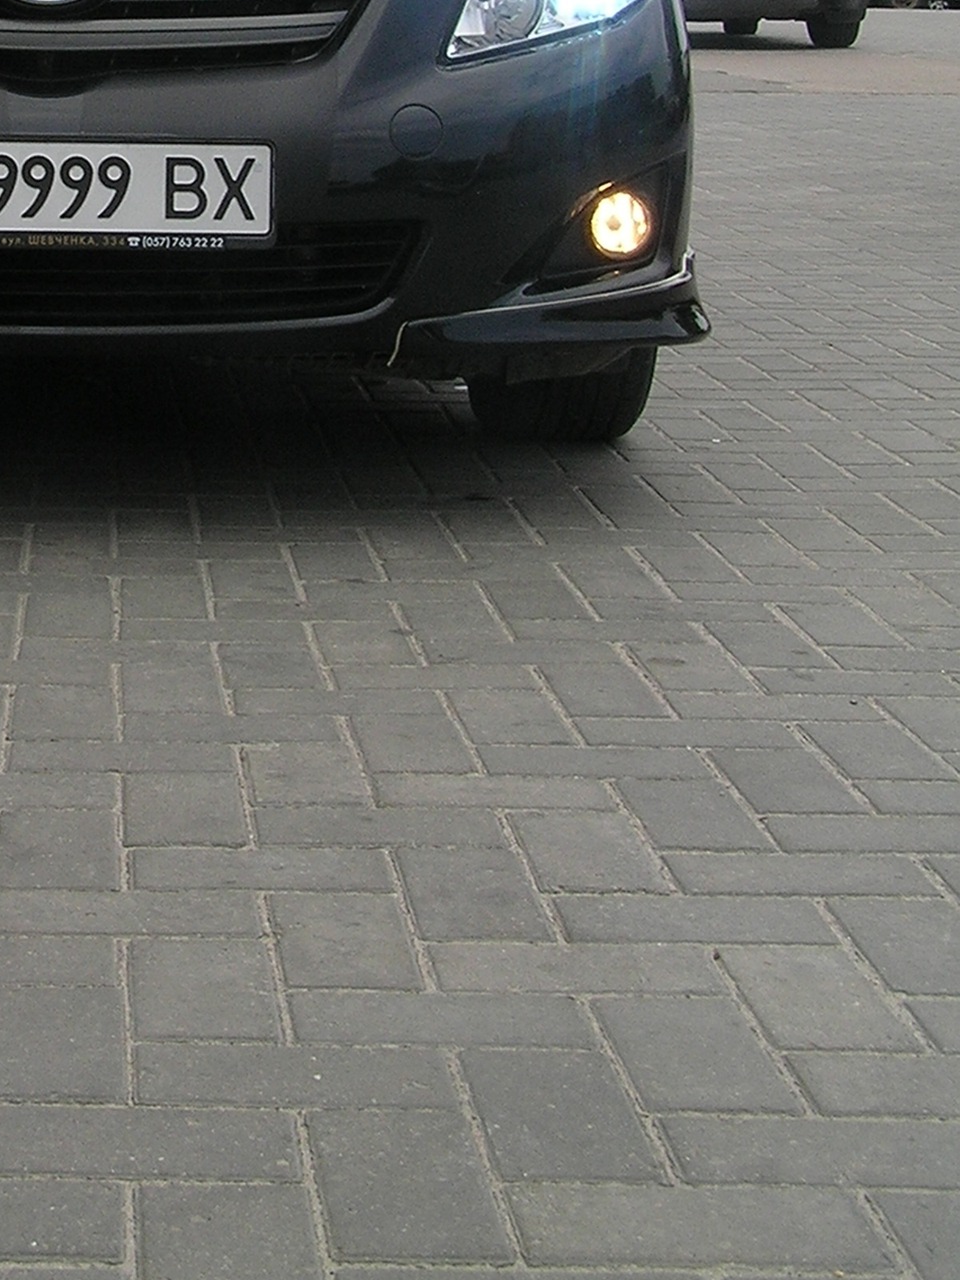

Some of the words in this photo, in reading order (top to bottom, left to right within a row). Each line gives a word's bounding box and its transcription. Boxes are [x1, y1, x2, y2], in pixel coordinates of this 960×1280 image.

[164, 157, 256, 221] BX
[142, 237, 171, 248] (057)
[172, 237, 192, 247] 763
[194, 238, 208, 248] 22
[210, 238, 224, 248] 22
